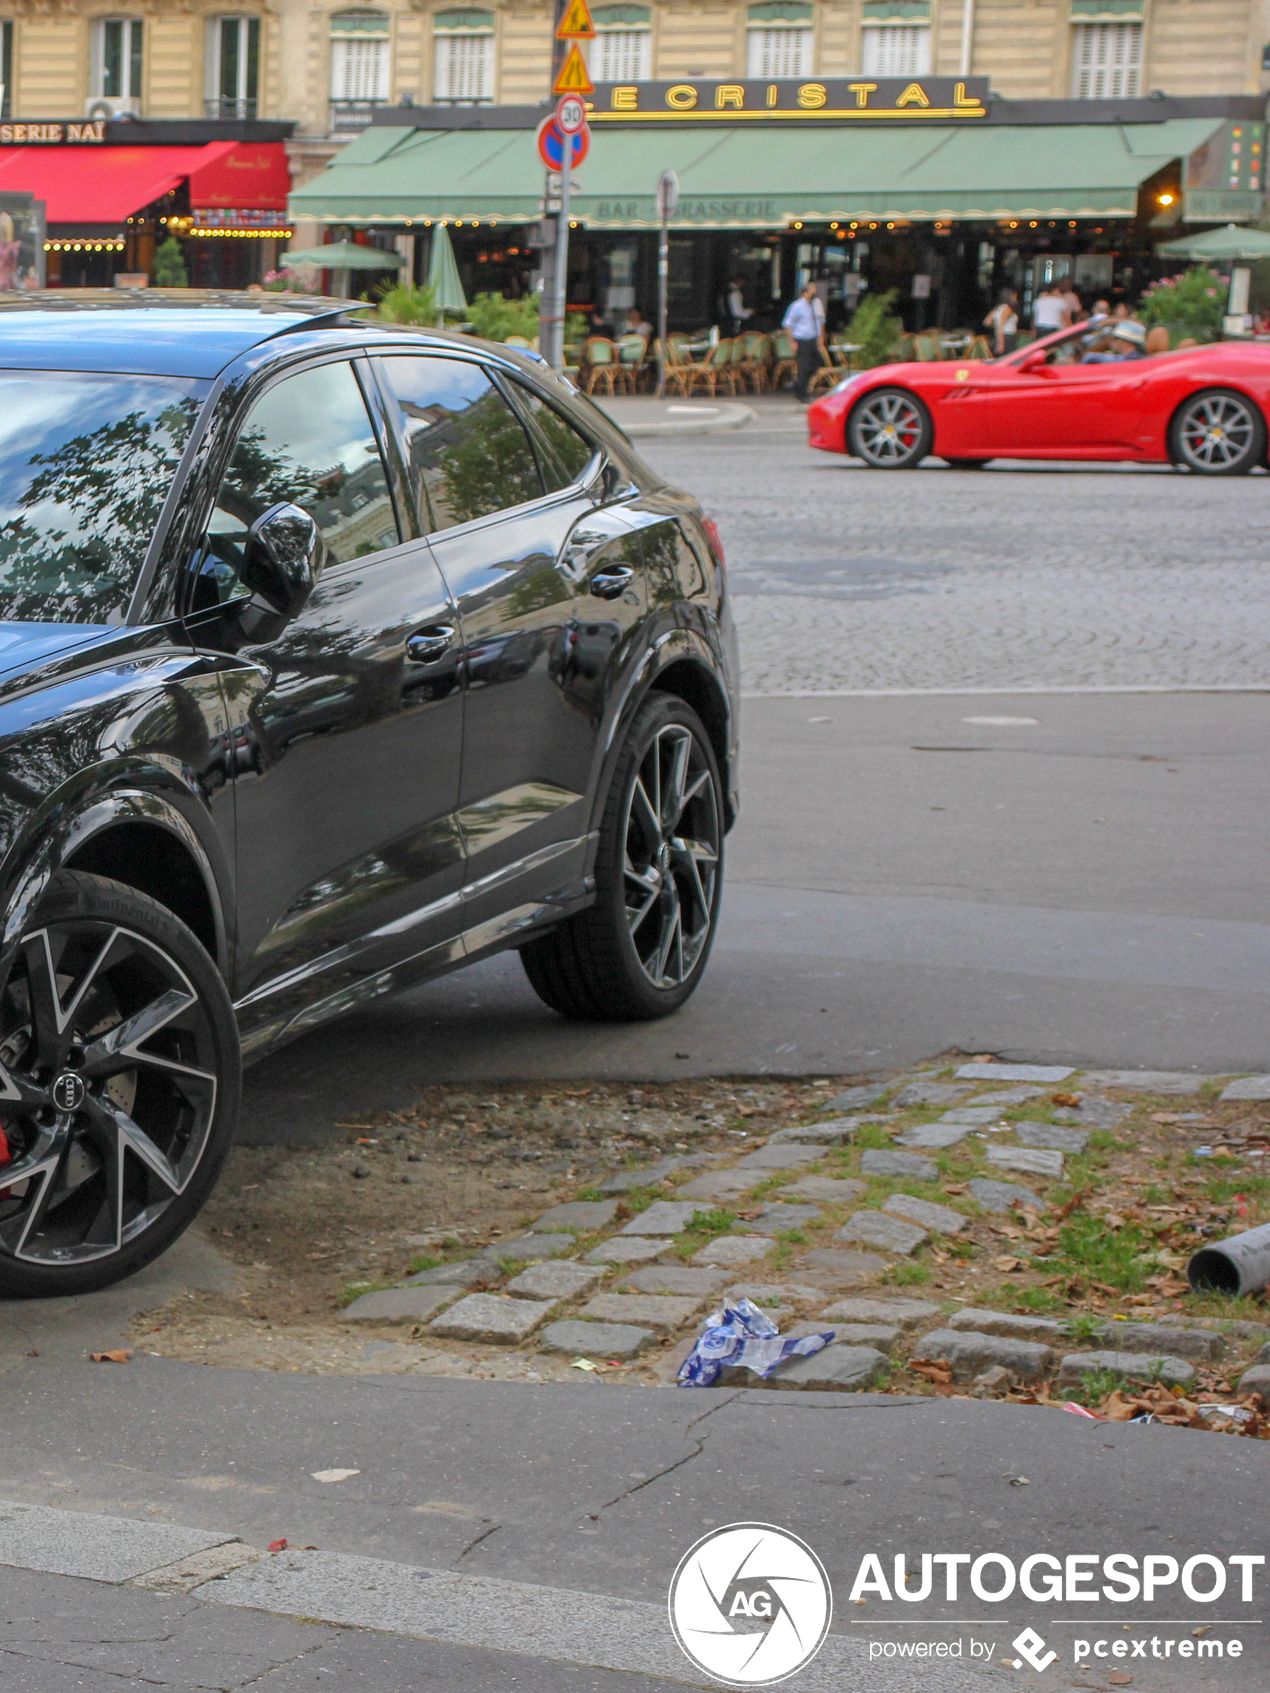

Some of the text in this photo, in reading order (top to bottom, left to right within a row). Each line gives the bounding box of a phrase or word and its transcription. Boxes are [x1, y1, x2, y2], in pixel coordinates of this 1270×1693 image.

[665, 82, 981, 110] CRISTAL
[564, 106, 582, 124] 30
[67, 121, 105, 143] NAÏ
[597, 201, 638, 218] BAR
